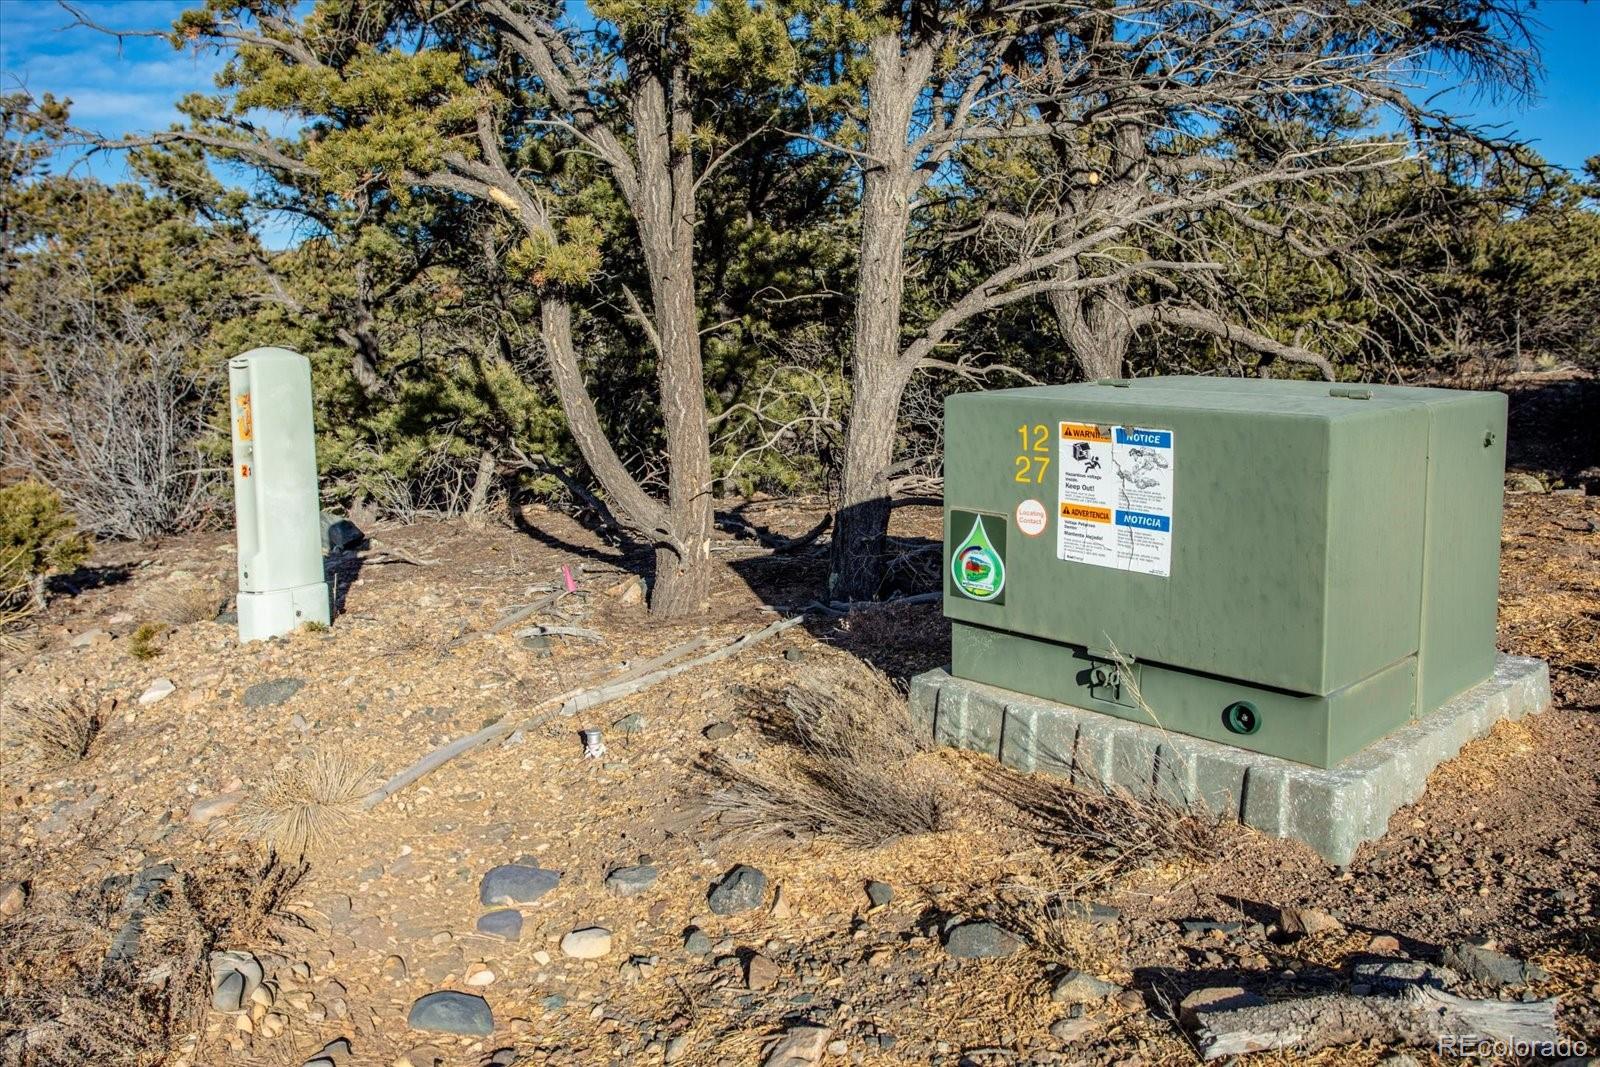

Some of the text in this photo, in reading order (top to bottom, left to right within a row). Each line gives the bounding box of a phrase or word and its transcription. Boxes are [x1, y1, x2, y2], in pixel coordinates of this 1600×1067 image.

[1017, 424, 1049, 452] 12
[1073, 429, 1108, 439] WARNI
[1126, 433, 1161, 444] NOTICE
[1015, 455, 1050, 483] 27
[1065, 482, 1081, 490] Keep
[1019, 509, 1044, 518] Locating
[1071, 508, 1110, 520] ADVERTENCIA
[1019, 516, 1042, 525] Contact
[1123, 514, 1161, 528] NOTICIA
